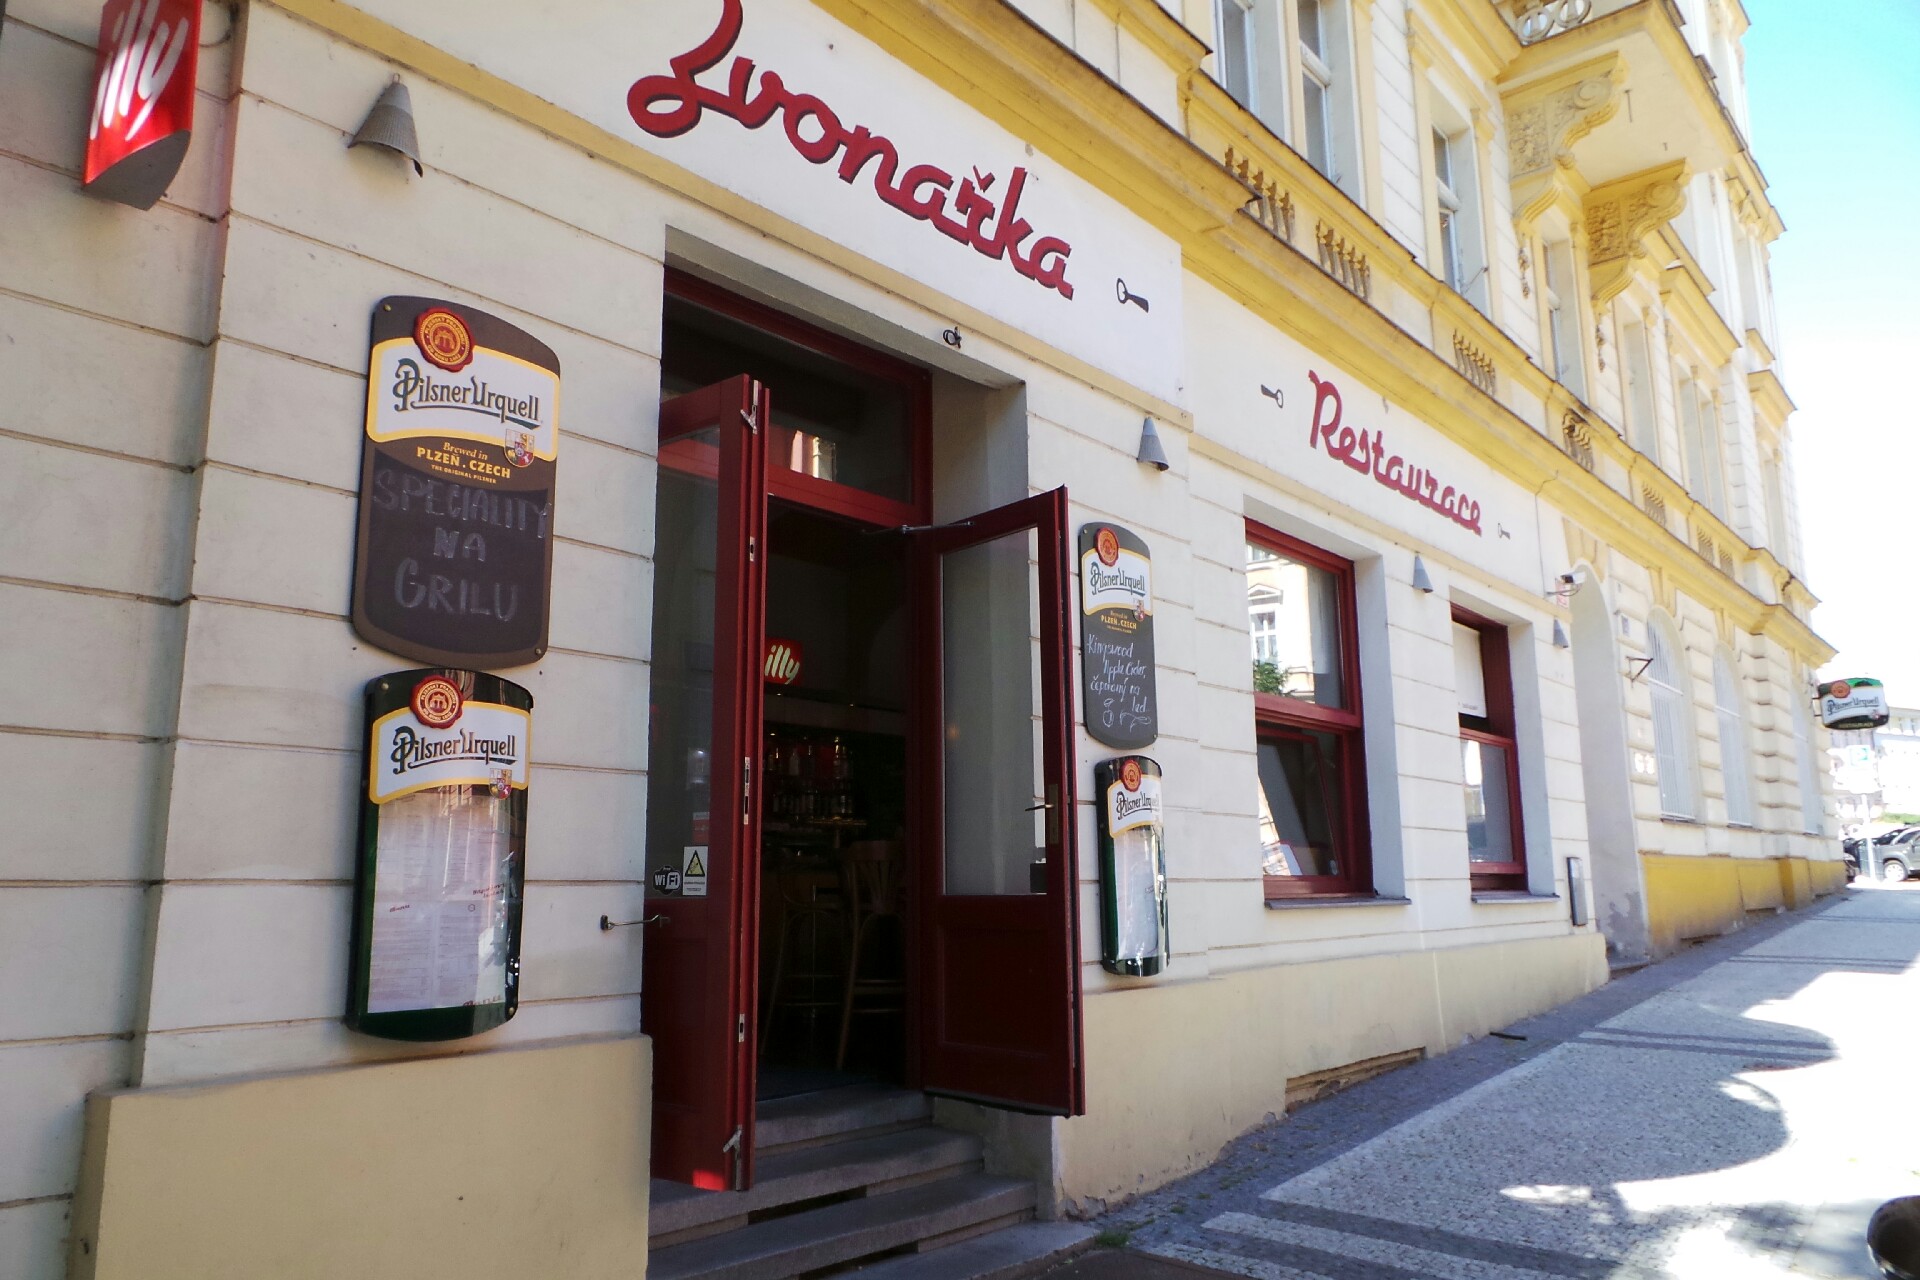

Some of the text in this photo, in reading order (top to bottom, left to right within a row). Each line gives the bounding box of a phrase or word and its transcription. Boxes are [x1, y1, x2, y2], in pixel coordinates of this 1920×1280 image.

[90, 0, 189, 141] illy
[392, 357, 540, 424] Pilsner Urquell
[416, 446, 511, 480] PLZEŇ CZECH
[443, 441, 488, 461] Brewed in
[1308, 369, 1482, 538] Restaurace
[433, 528, 487, 562] NA
[394, 557, 519, 622] GRILU
[1090, 561, 1145, 596] Pilsner Urquell
[1120, 619, 1137, 630] CZECH
[764, 644, 800, 685] illy
[390, 726, 517, 775] Pilsner Urquell
[1116, 791, 1141, 821] Pilsner
